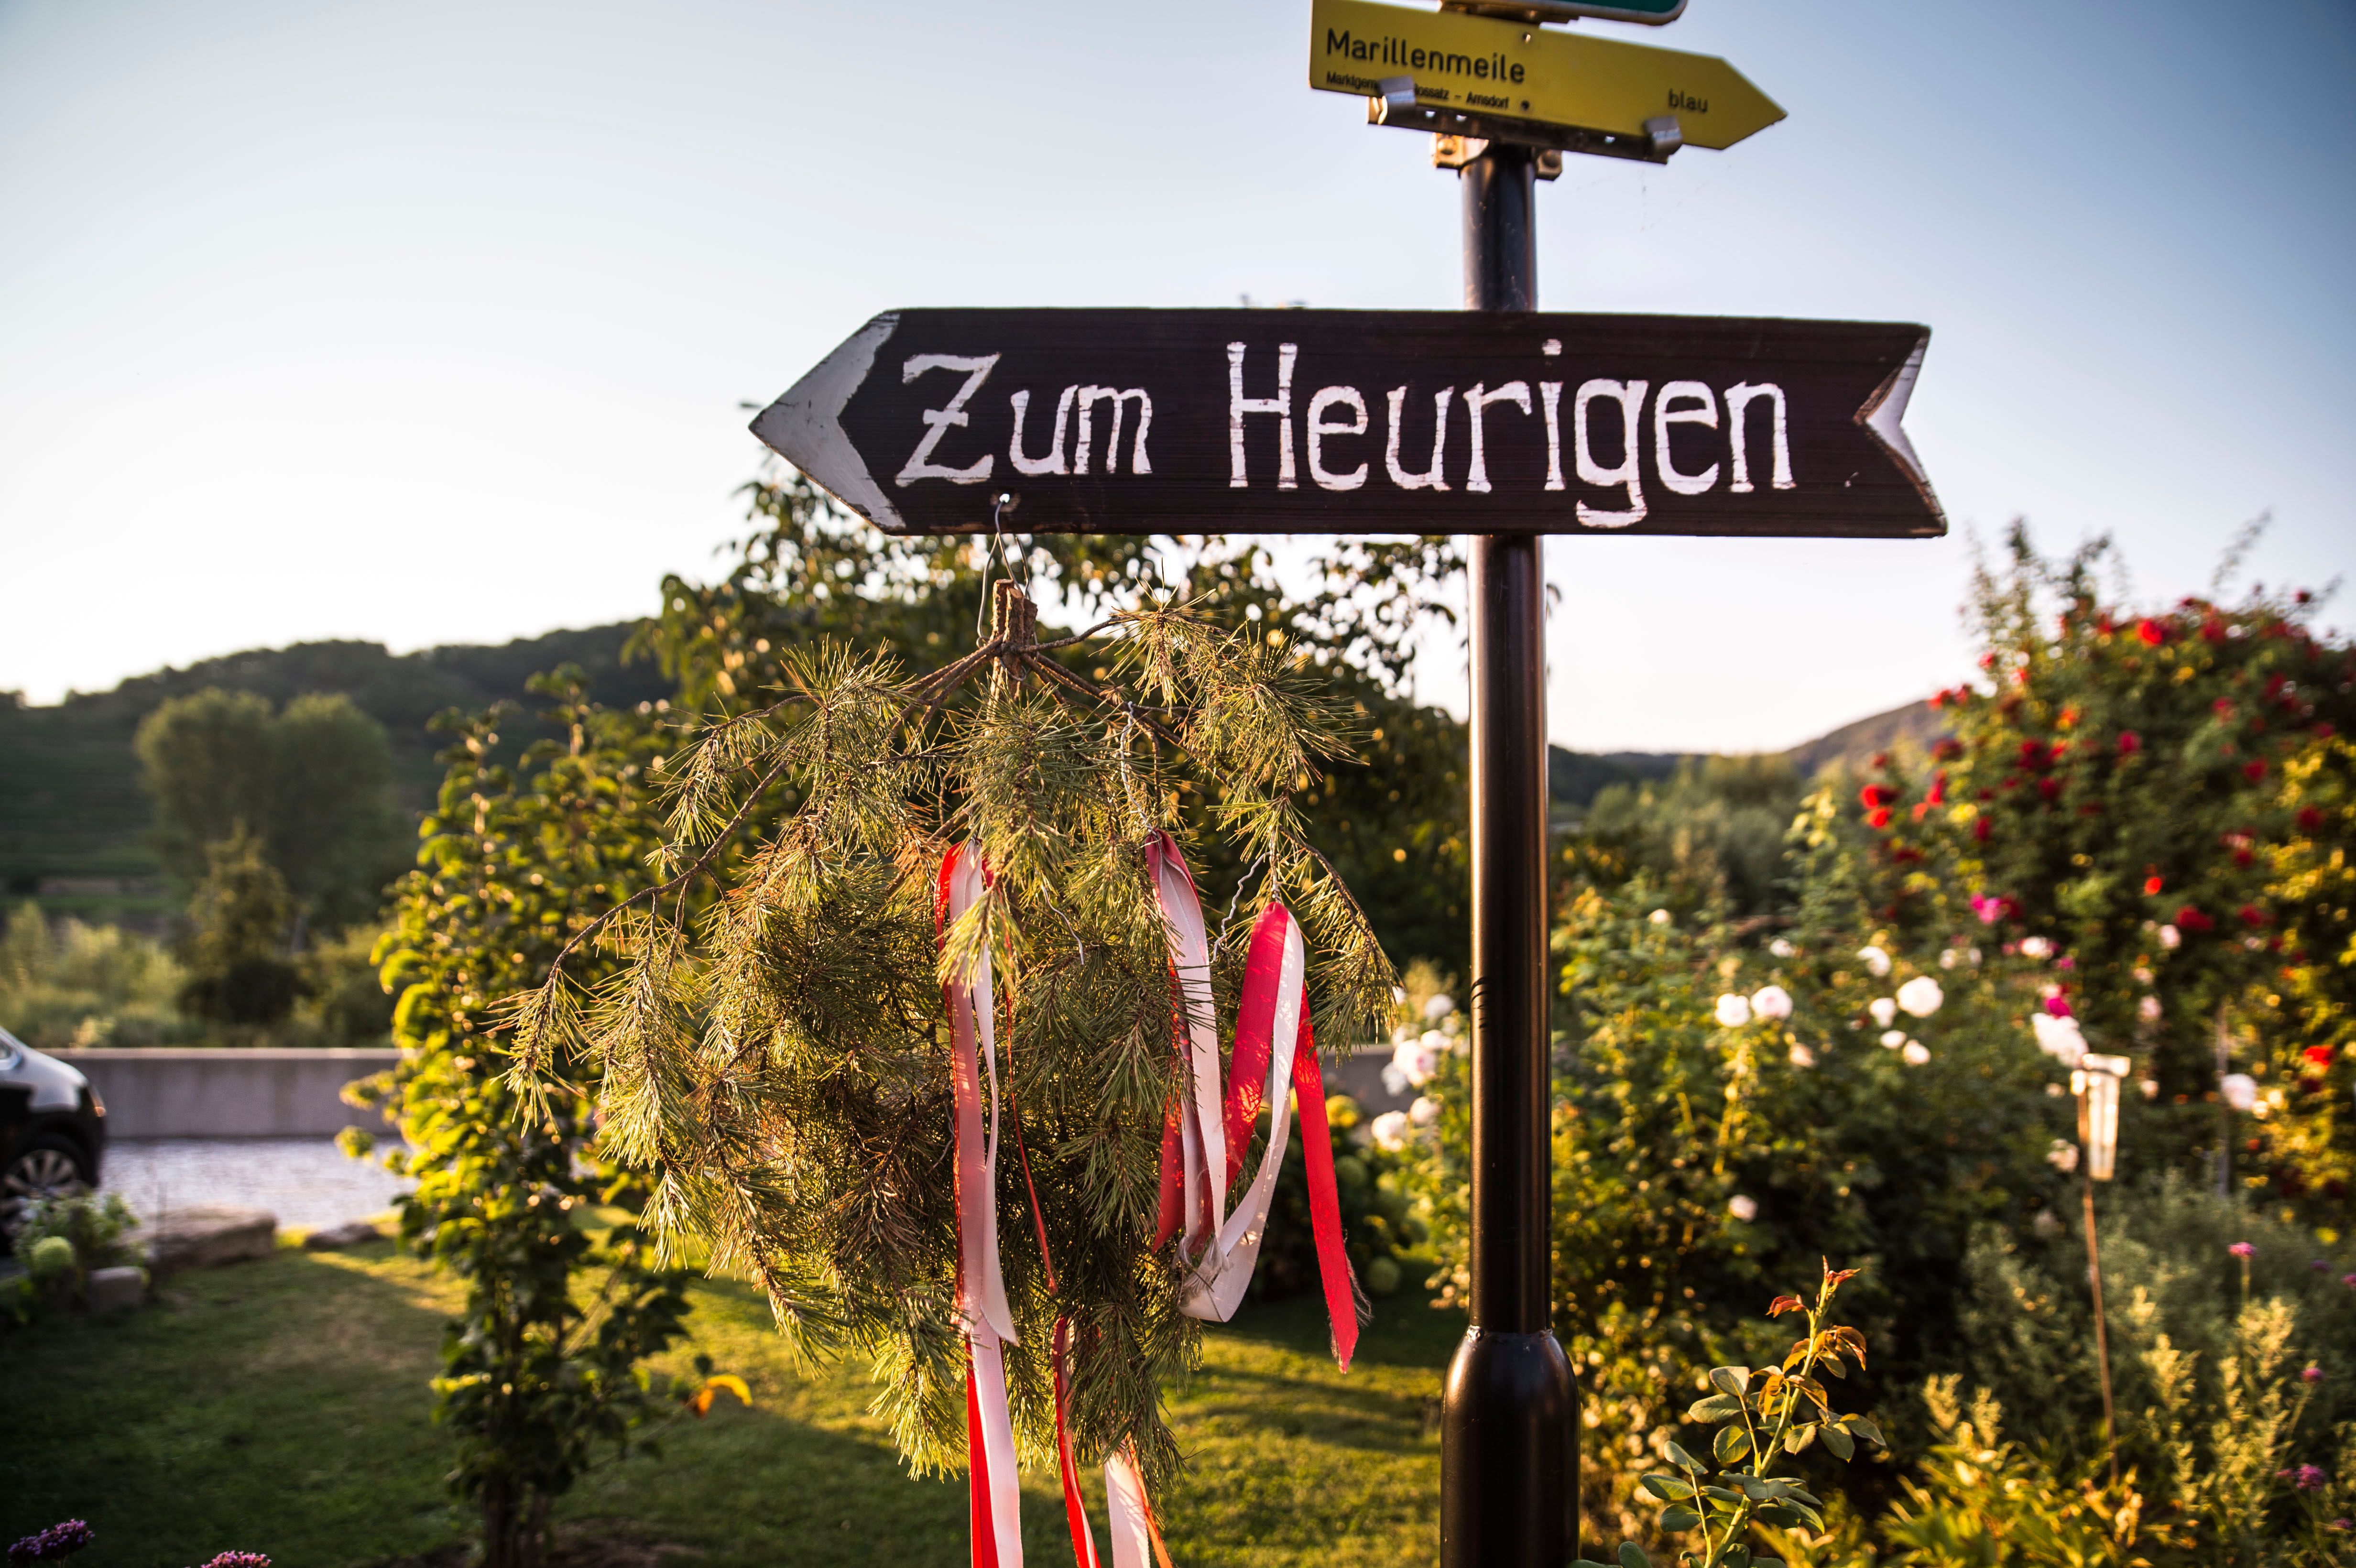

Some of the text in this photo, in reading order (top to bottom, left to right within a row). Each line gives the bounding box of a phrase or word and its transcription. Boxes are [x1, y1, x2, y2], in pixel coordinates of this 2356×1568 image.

[1327, 27, 1525, 83] Marillenmeile
[1326, 71, 1380, 90] Marktgem
[1466, 91, 1509, 108] Arnsdorf
[1669, 88, 1708, 113] blau
[895, 338, 1796, 528] Zum Heurigen
